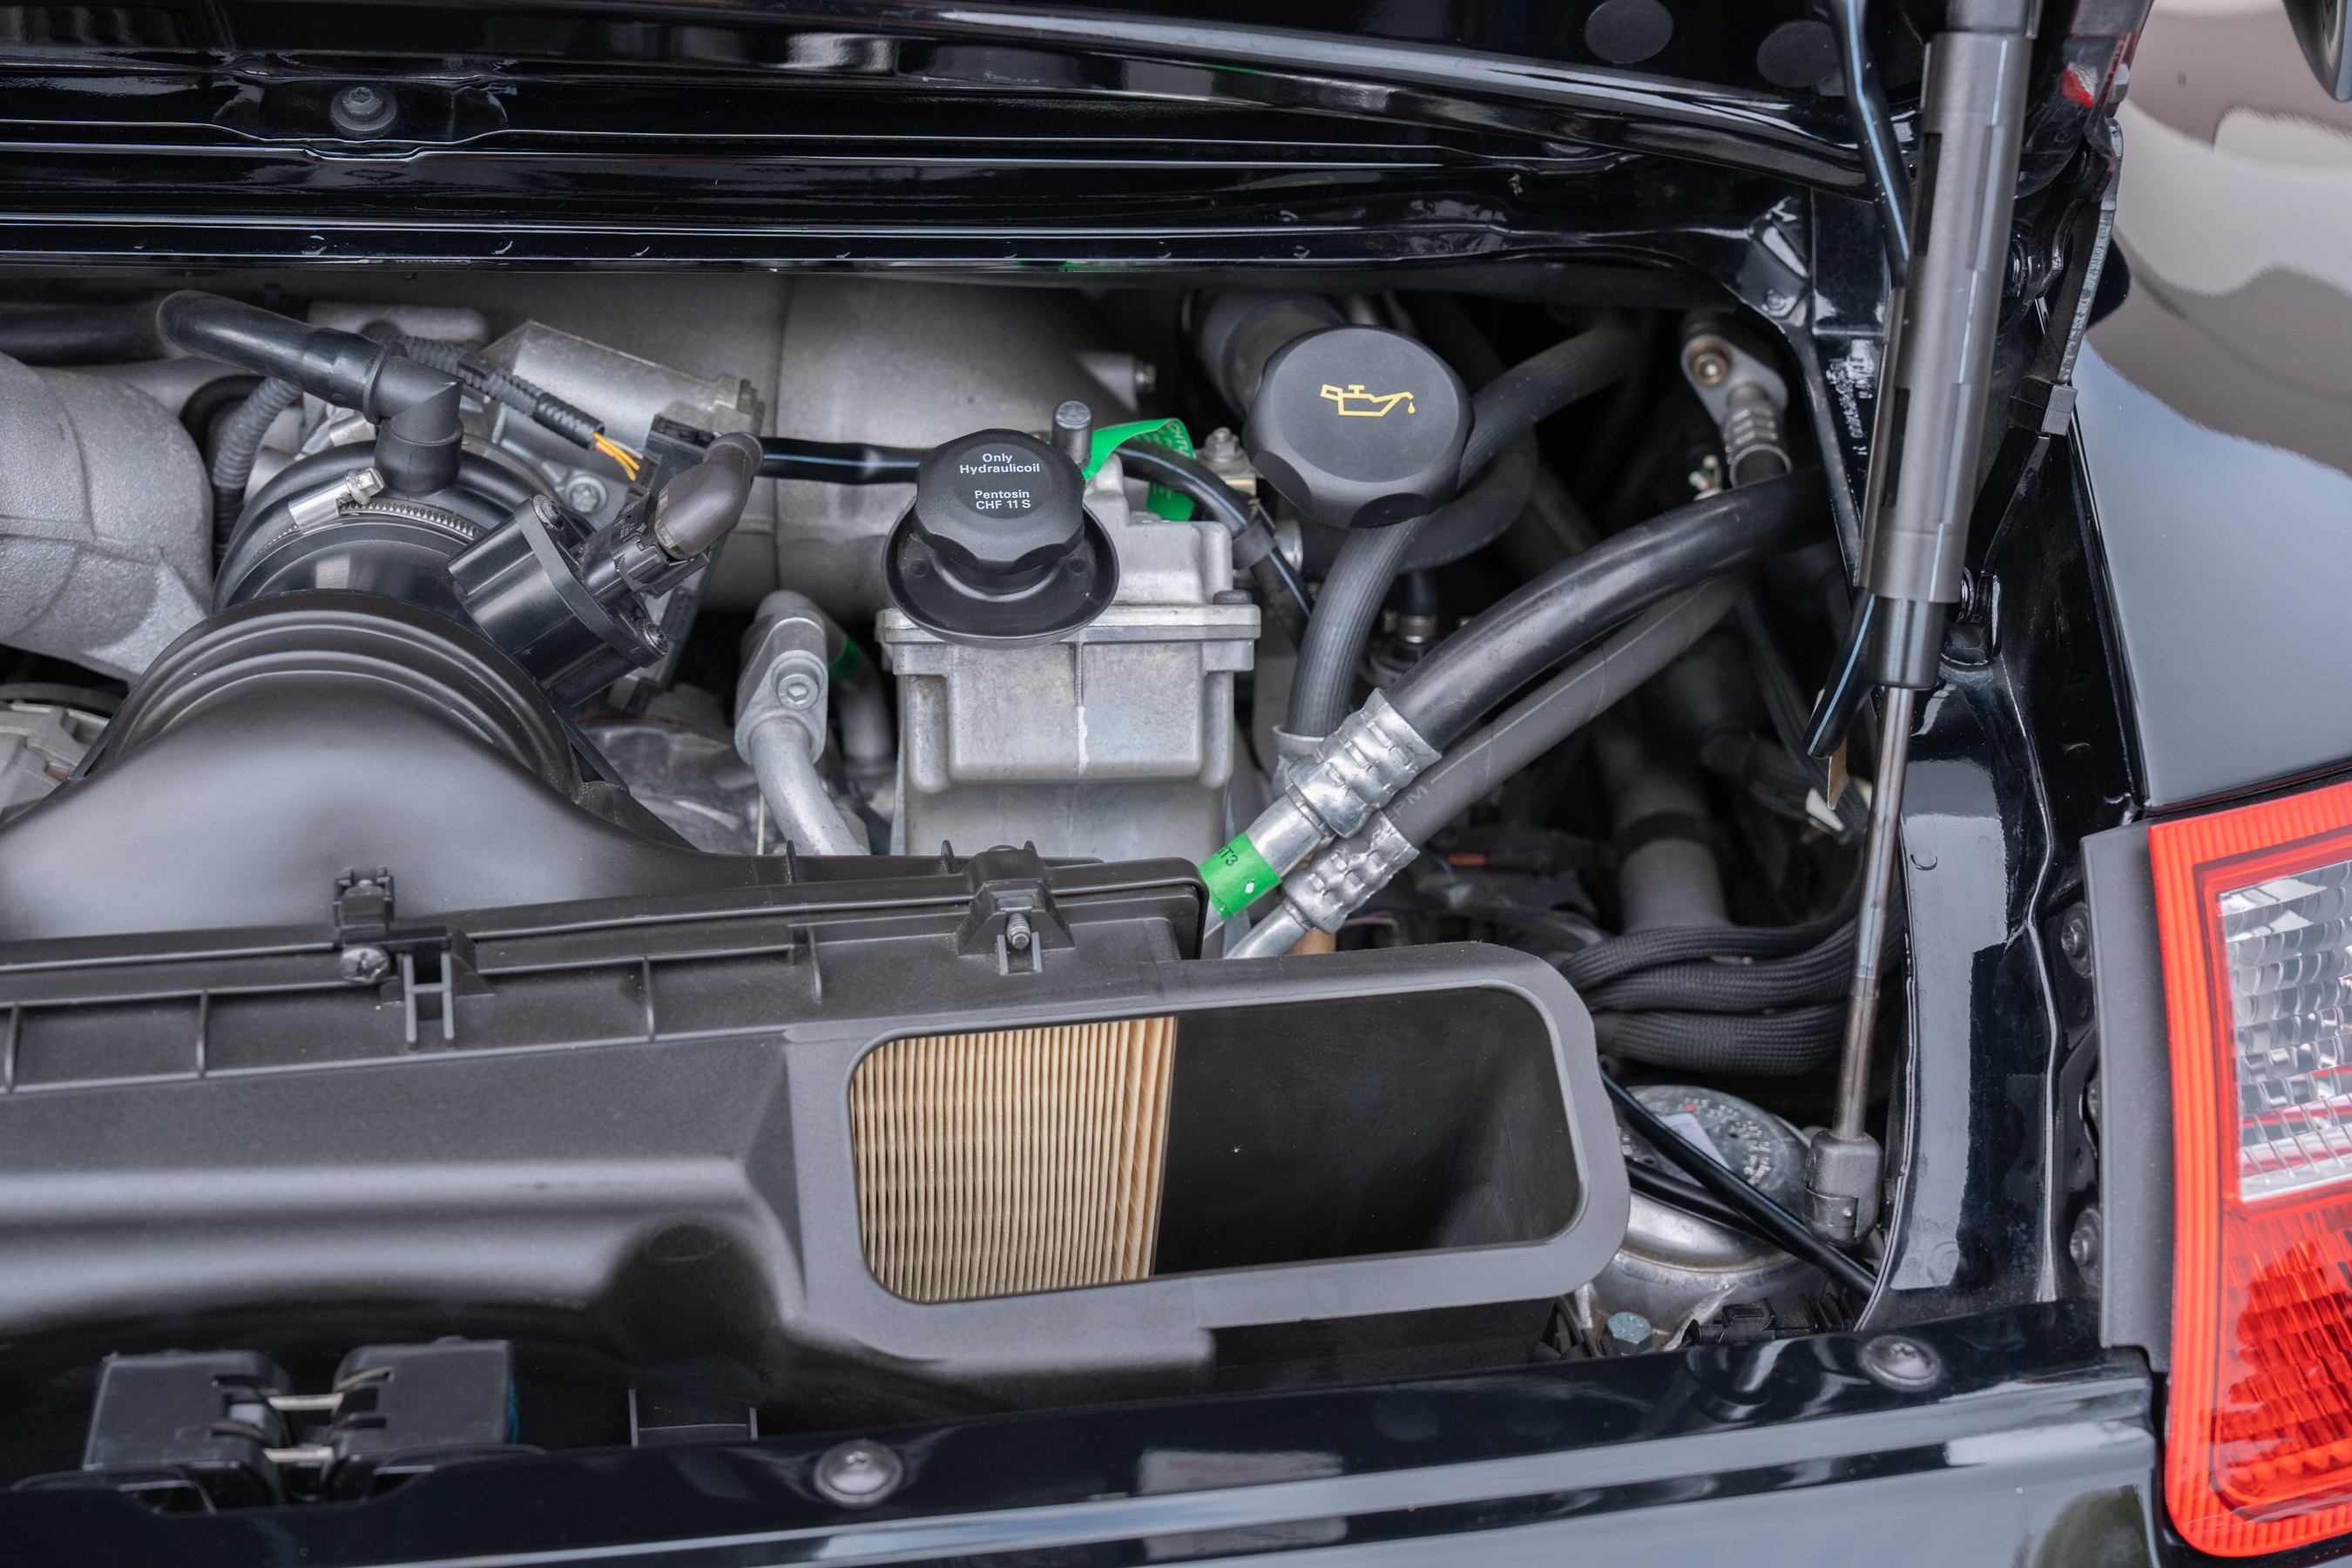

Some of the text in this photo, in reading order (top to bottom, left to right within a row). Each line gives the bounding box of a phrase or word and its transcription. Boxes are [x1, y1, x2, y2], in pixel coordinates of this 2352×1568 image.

[982, 453, 1013, 464] Only
[959, 463, 1040, 475] Hydraulicoil
[974, 490, 1030, 499] Pentosin
[976, 499, 1031, 510] CHF 11 S
